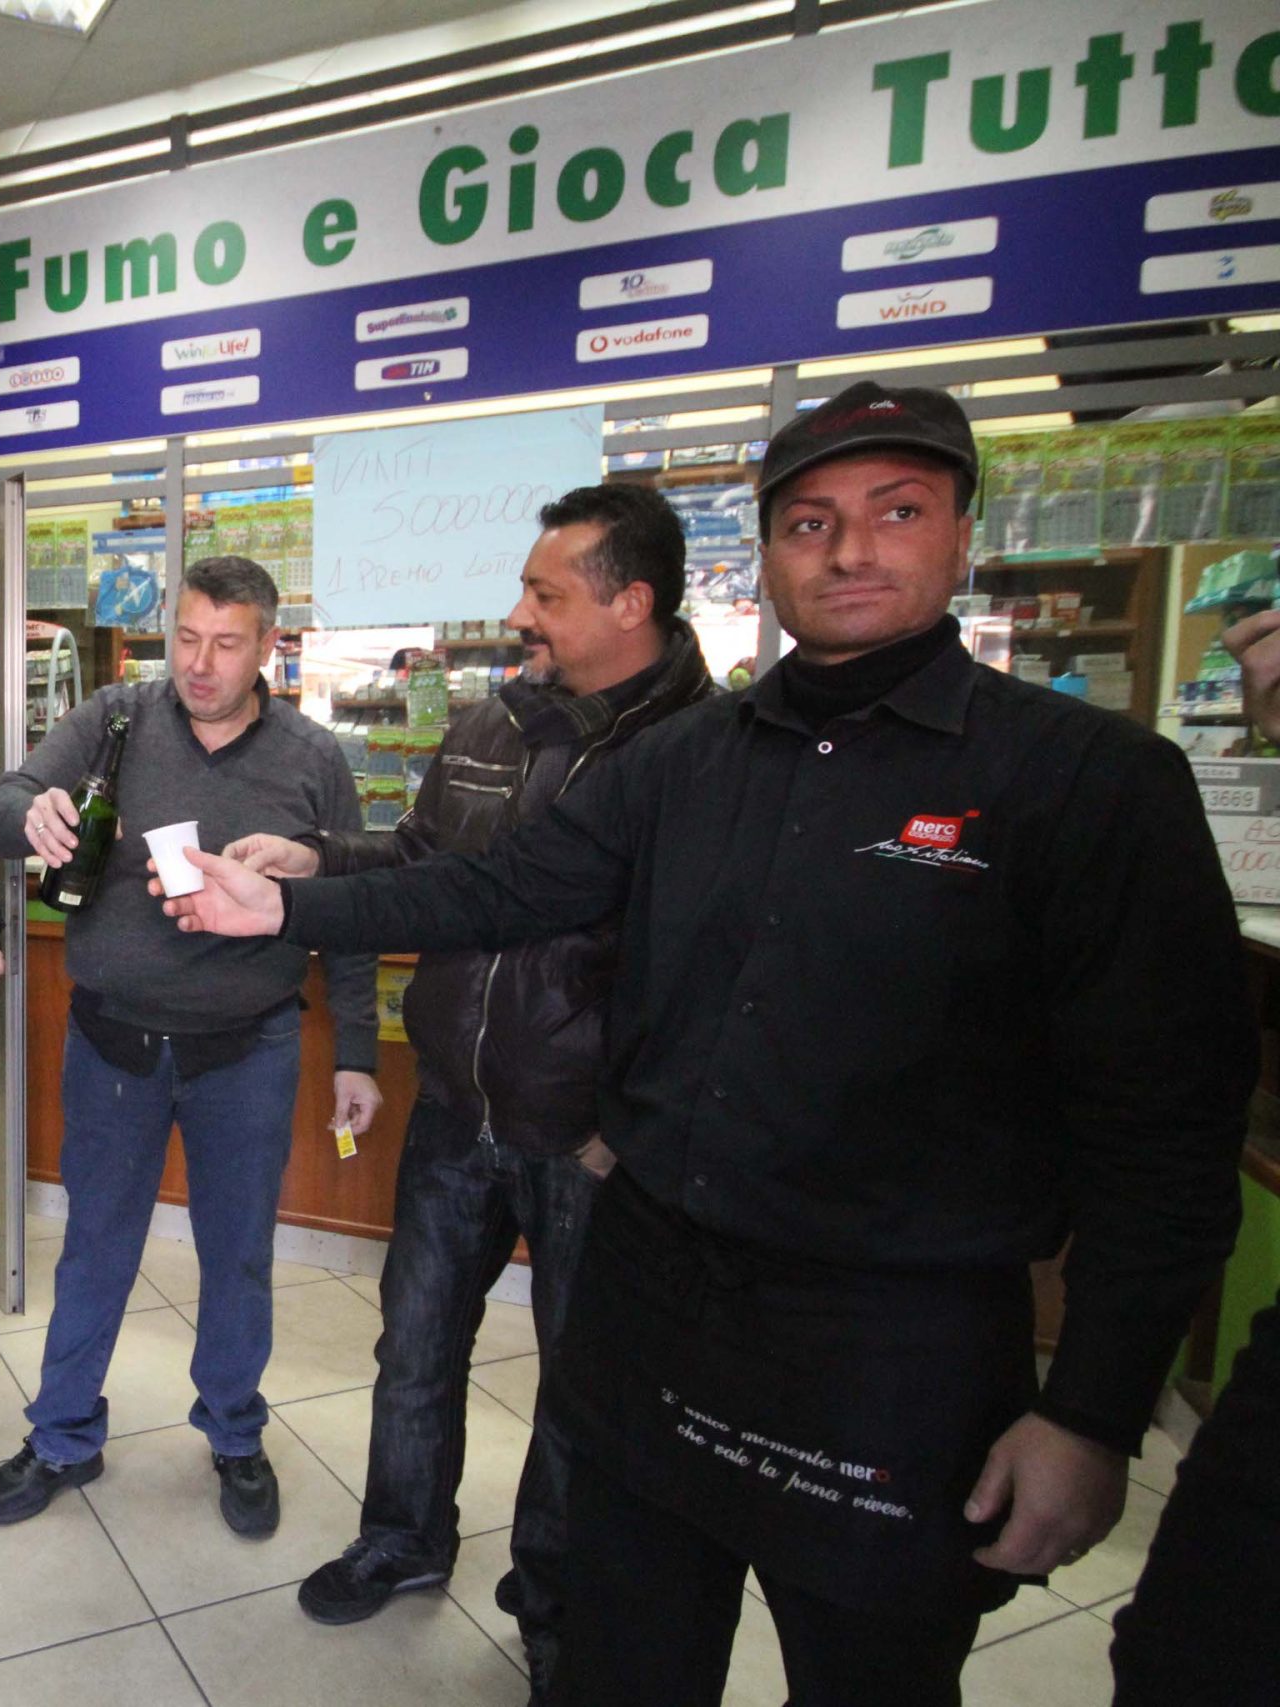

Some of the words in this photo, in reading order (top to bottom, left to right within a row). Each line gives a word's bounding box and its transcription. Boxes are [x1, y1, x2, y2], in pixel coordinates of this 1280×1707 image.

[303, 197, 358, 268] e
[420, 112, 791, 246] Gioca
[872, 20, 1280, 169] Tutto
[620, 273, 645, 293] 10
[880, 299, 946, 319] WIND
[613, 326, 694, 348] vodafone
[410, 360, 436, 377] TIM
[326, 556, 349, 597] 1
[358, 557, 443, 593] PREMIO
[911, 819, 956, 836] nero
[919, 848, 989, 869] italiano
[677, 1422, 708, 1447] che
[714, 1442, 751, 1468] vale
[759, 1456, 780, 1480] la
[782, 1471, 844, 1505] pena
[740, 1429, 835, 1472] momento
[839, 1460, 892, 1484] nero
